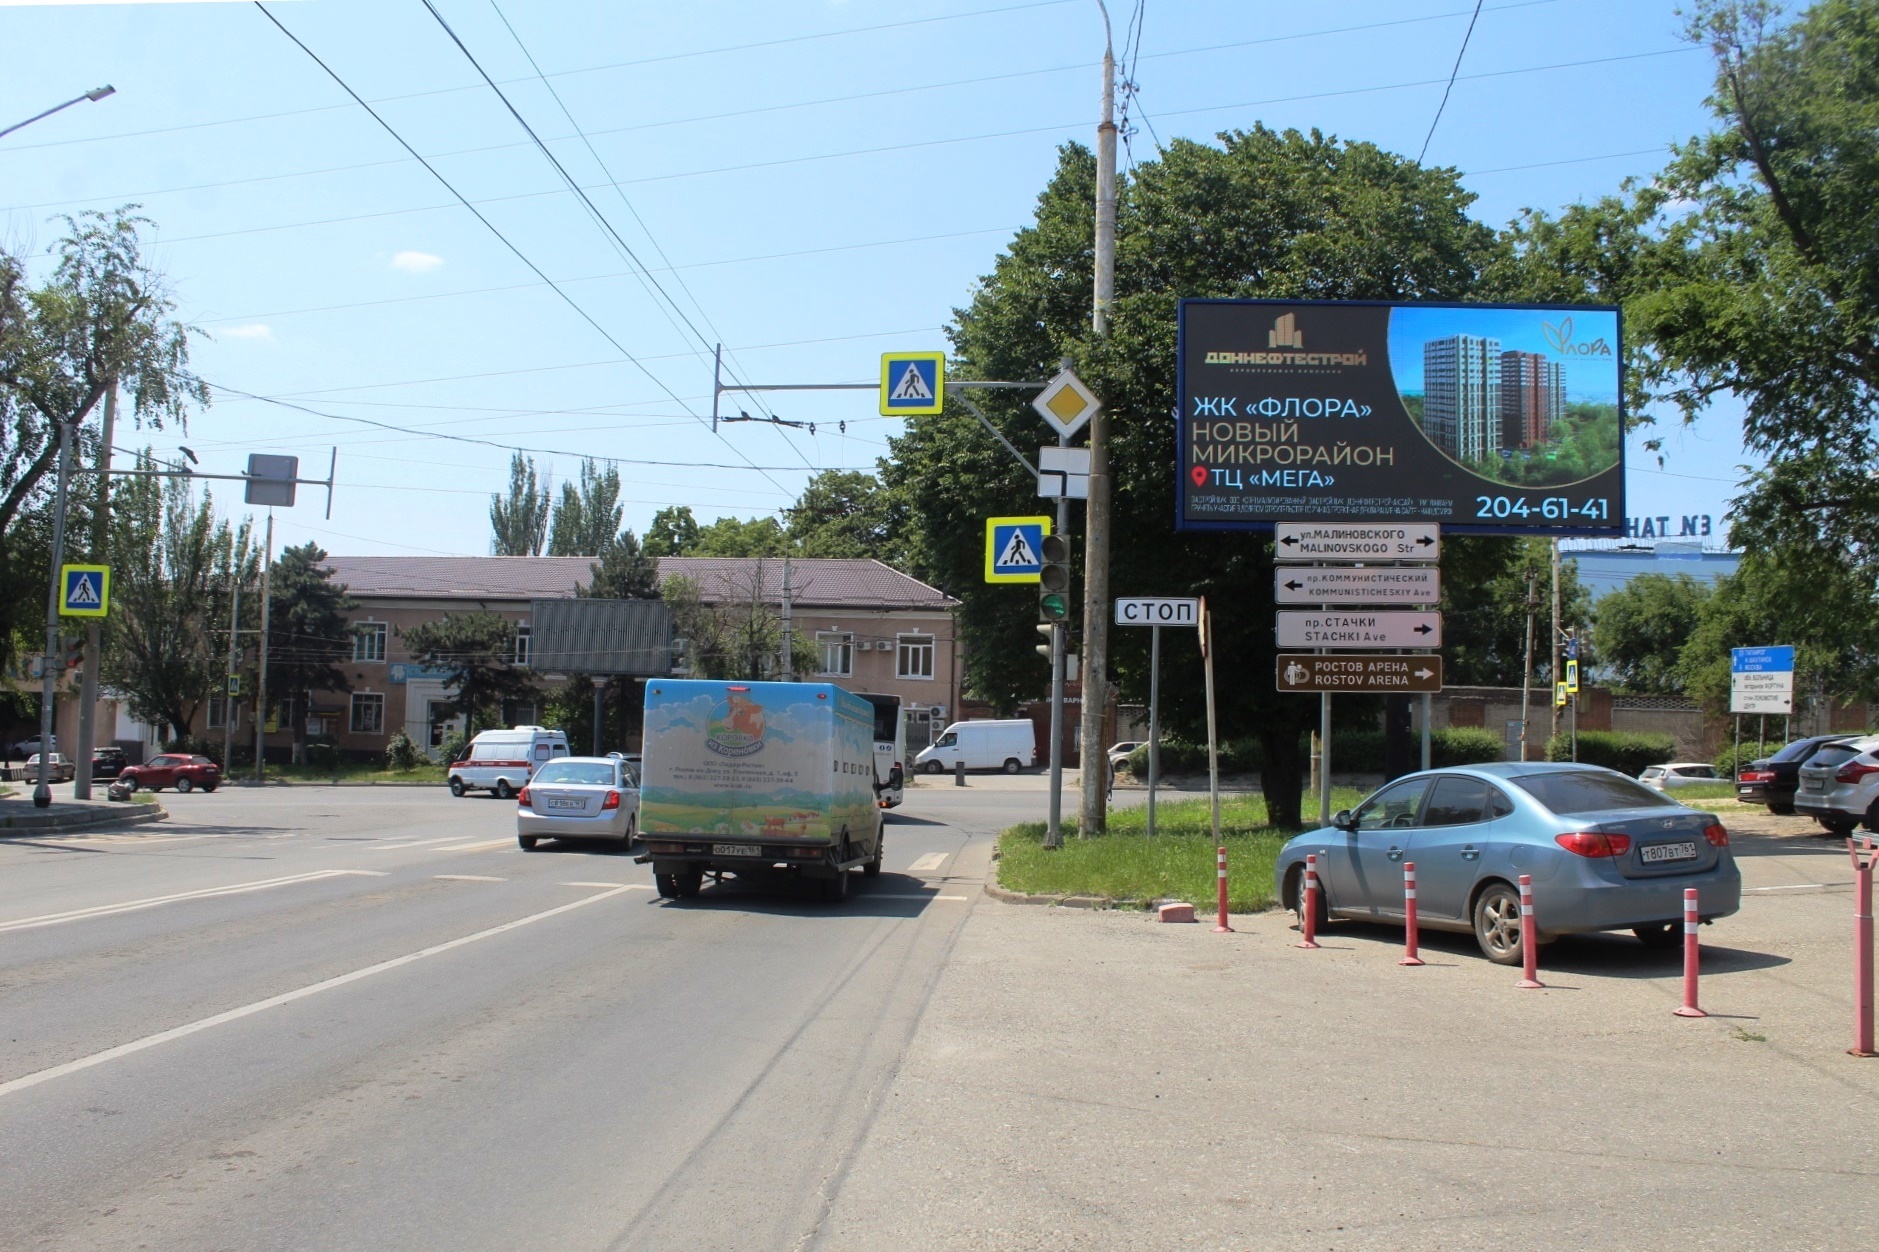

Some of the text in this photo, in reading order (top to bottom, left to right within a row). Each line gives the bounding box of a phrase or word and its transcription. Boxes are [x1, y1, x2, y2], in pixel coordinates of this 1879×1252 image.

[1205, 349, 1367, 366] ДОННЕФТЕСТРОЙ
[1193, 397, 1372, 418] ЖК «ФЛОРА»
[1192, 419, 1298, 443] НОВЫЙ
[1192, 441, 1394, 466] МИКРОРАЙОН
[1211, 469, 1335, 490] ТЦ «МЕГА»
[1476, 496, 1608, 520] 204-61-41
[1300, 543, 1415, 553] MALINOVSKOGO Str
[1309, 588, 1411, 596] KOMMUNISTICHESKIY
[1124, 603, 1191, 620] СТОП
[1305, 632, 1386, 641] STACHKI Ave
[1315, 662, 1409, 672] РОСТОВ АРЕНА
[1315, 675, 1409, 685] ROSTOV ARENA
[717, 733, 754, 742] КОРОВКА
